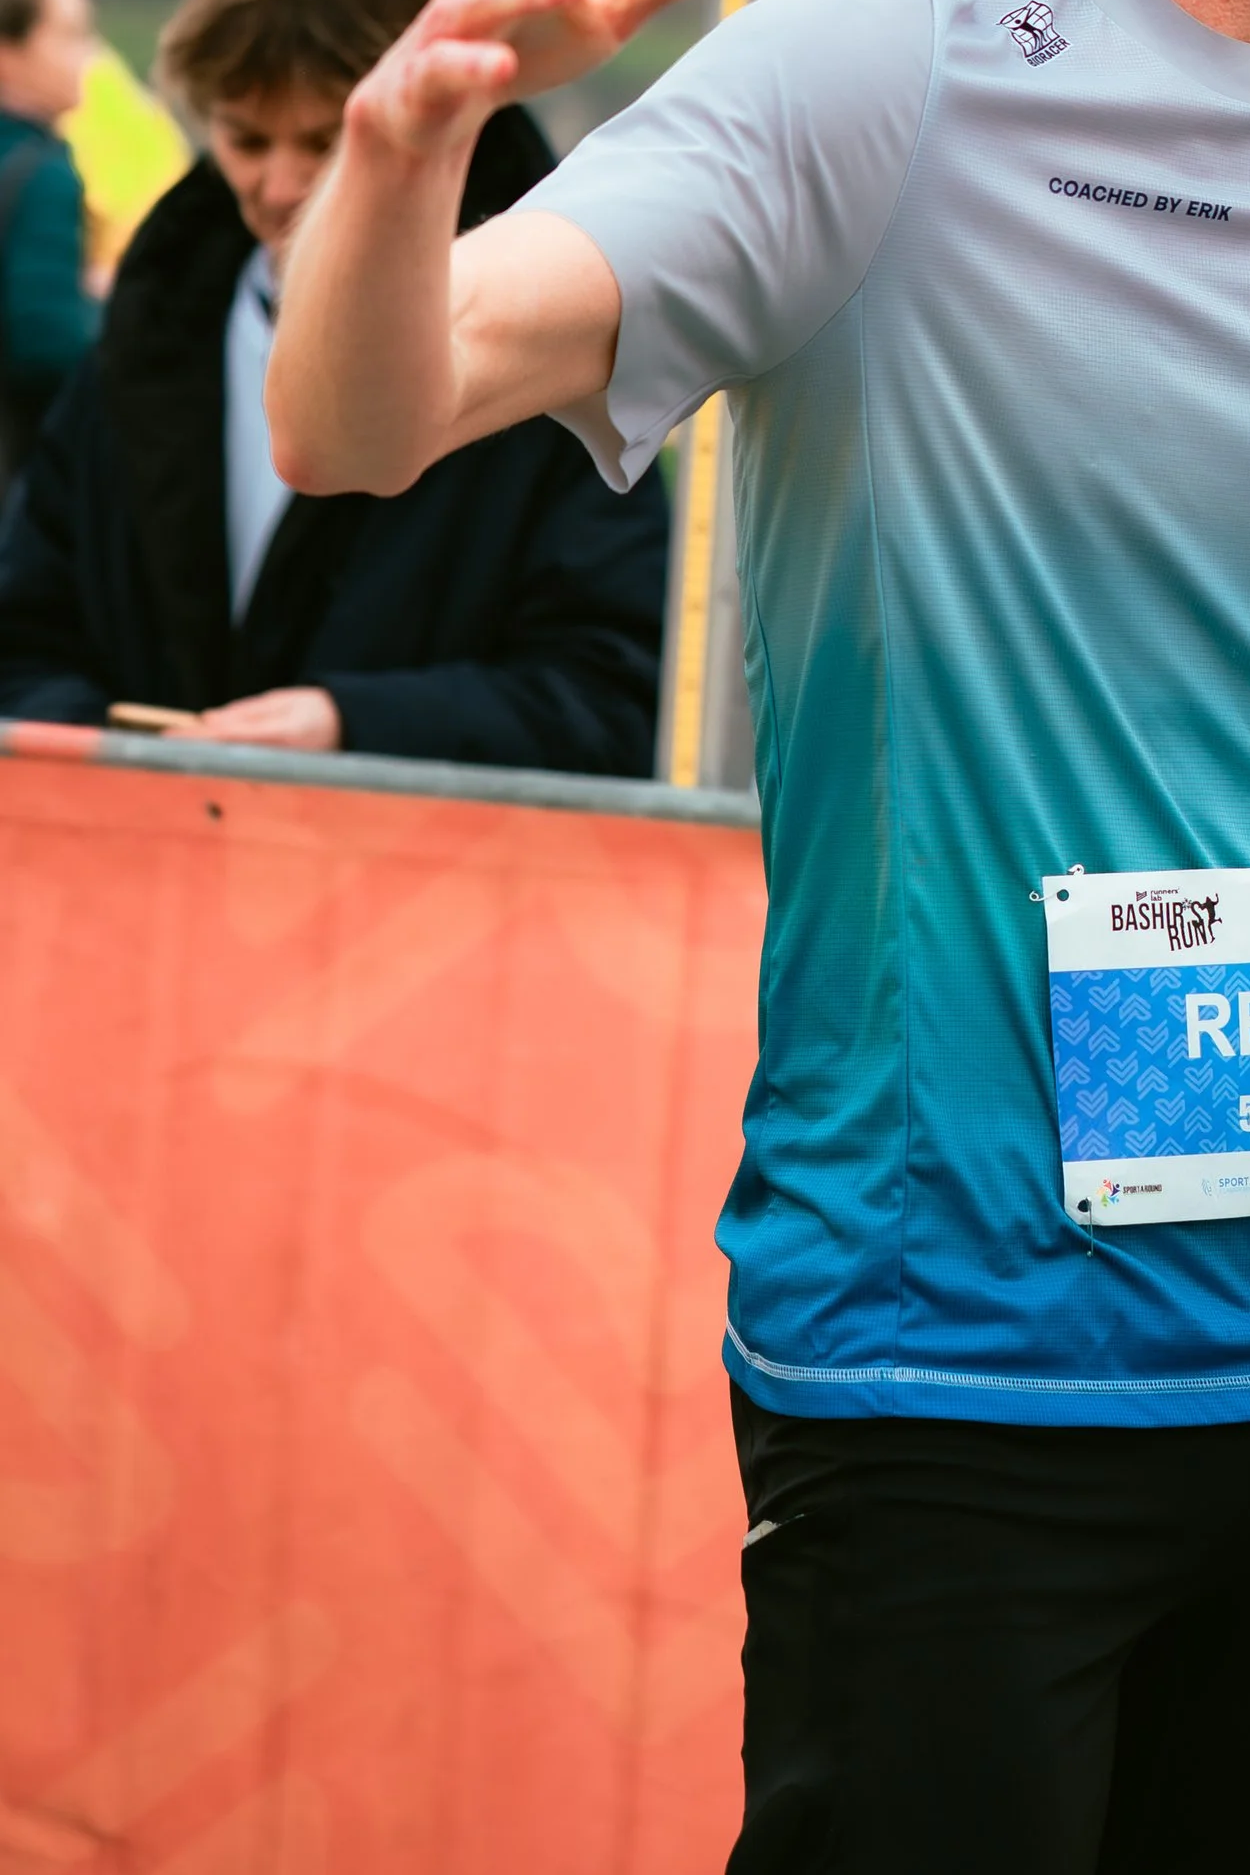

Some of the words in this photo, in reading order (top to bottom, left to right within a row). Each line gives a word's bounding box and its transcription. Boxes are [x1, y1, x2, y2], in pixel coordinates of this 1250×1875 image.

[1026, 38, 1071, 67] BIORACER
[1048, 177, 1148, 208] COACHED
[1153, 195, 1182, 213] BY
[1185, 200, 1232, 221] ERIK
[1167, 919, 1208, 952] RUN
